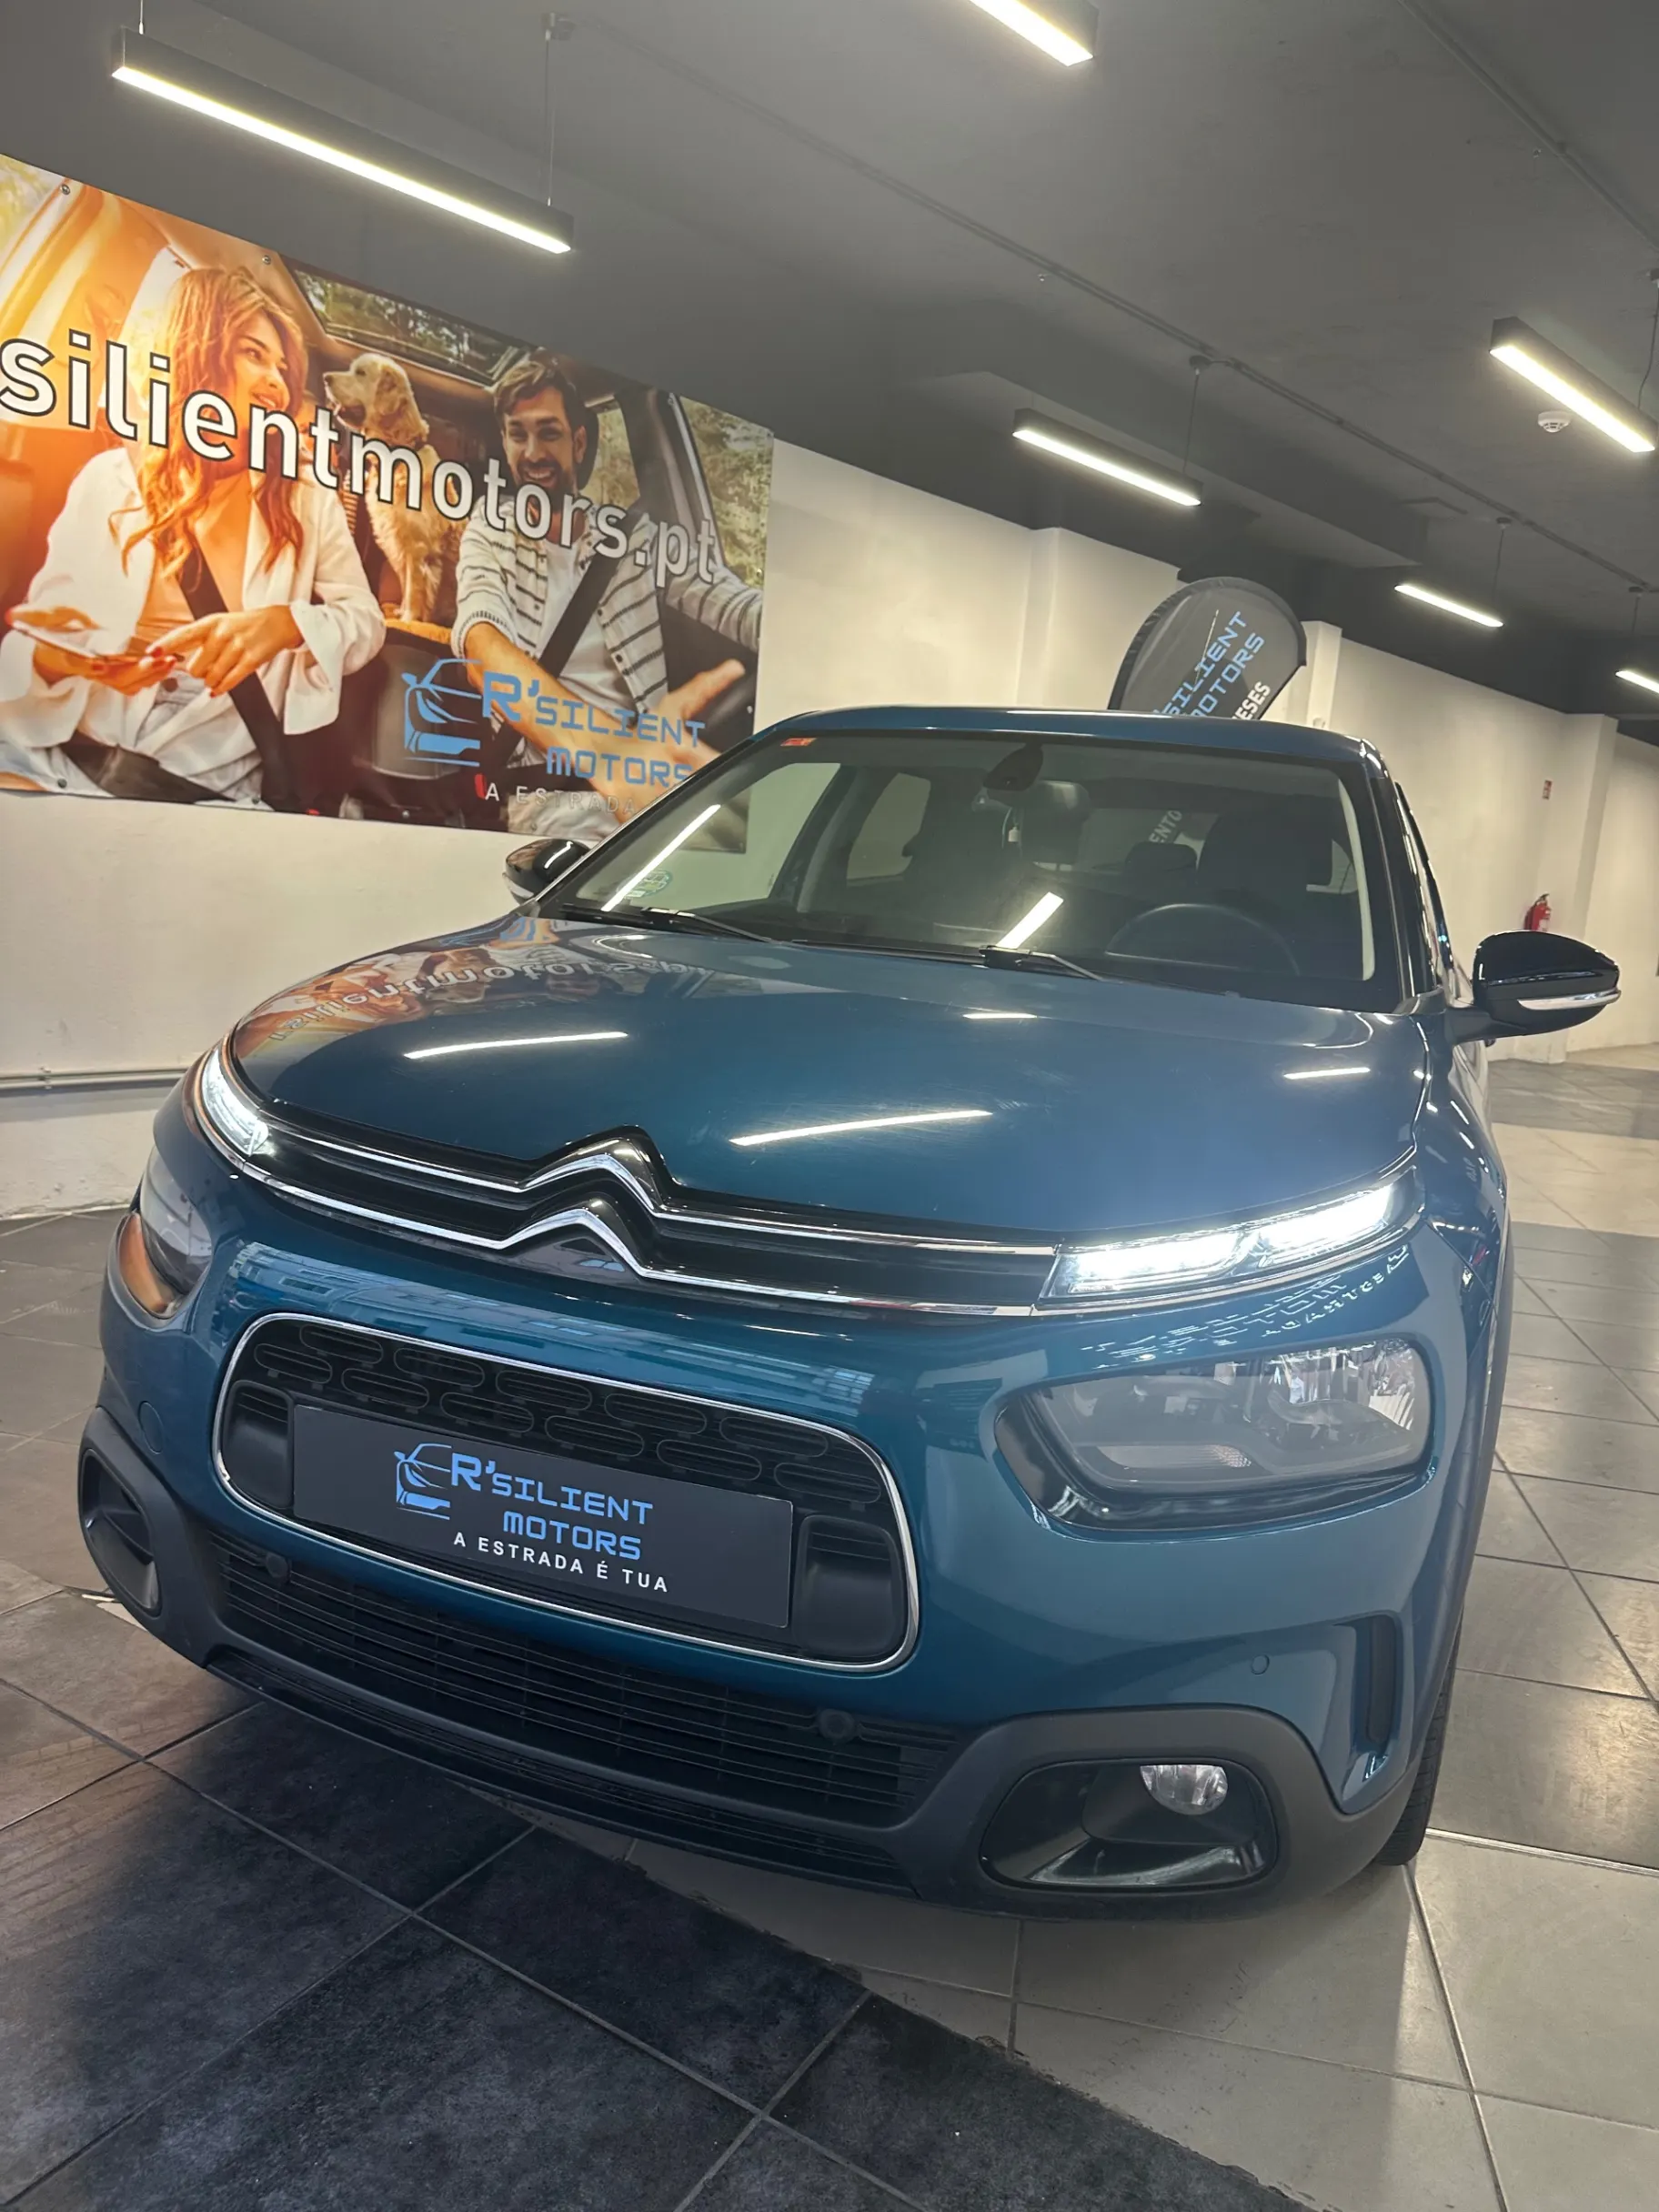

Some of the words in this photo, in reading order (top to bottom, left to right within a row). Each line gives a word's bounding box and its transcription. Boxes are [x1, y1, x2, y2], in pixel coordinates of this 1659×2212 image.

[0, 328, 716, 588] silientmotors.pt
[482, 670, 706, 748] R'SILIENT
[1232, 680, 1271, 719] ESES
[546, 745, 693, 789] MOTORS
[484, 781, 500, 801] A
[516, 785, 636, 816] ESTRADA
[450, 1453, 654, 1525] R'SILIENT
[453, 1532, 467, 1547] A
[478, 1537, 584, 1574] ESTRADA
[596, 1560, 608, 1580] É
[621, 1568, 669, 1593] TUA
[502, 1510, 641, 1561] MOTORS
